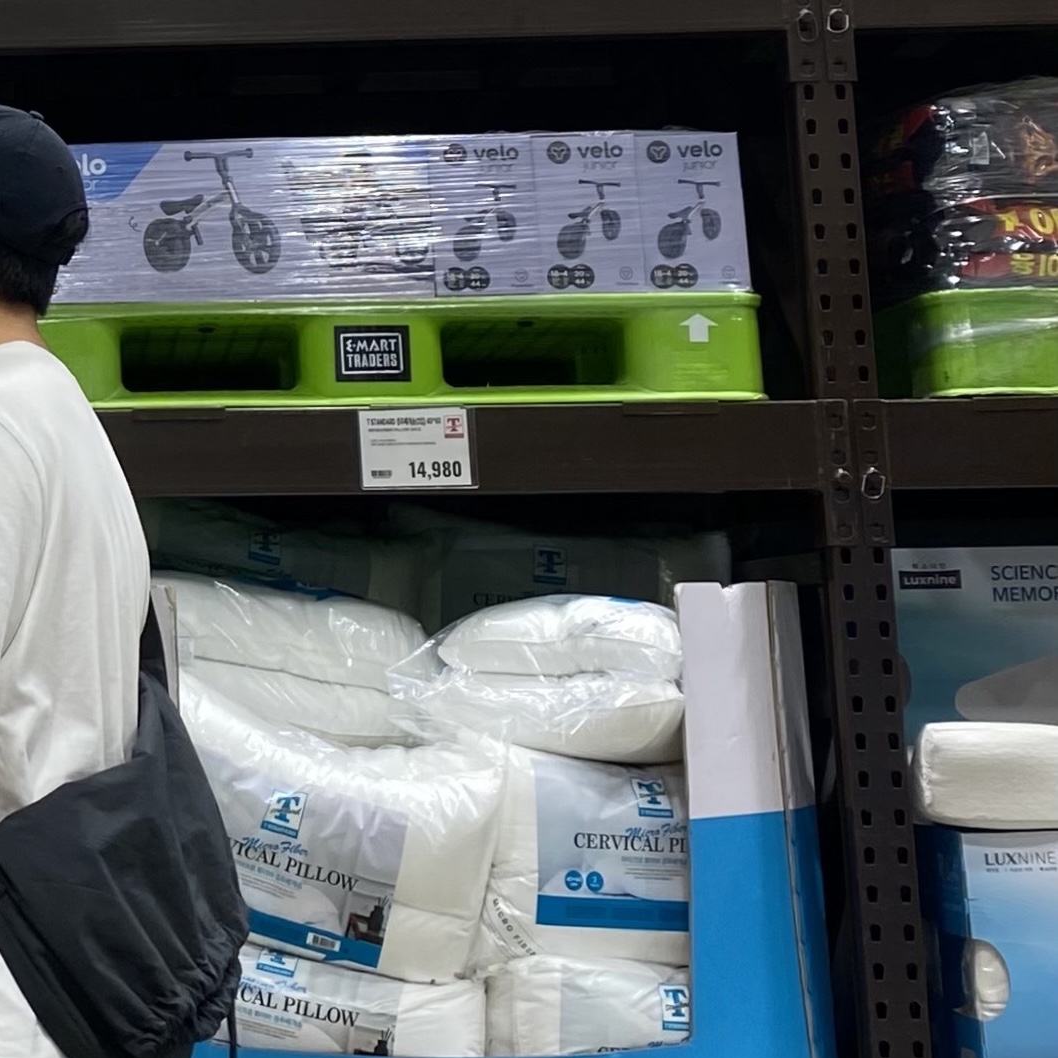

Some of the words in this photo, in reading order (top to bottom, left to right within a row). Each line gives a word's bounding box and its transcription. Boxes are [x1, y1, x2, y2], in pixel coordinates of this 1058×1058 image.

[577, 141, 624, 157] velo
[677, 140, 723, 157] velo
[75, 153, 107, 176] lo
[683, 159, 718, 172] junior
[346, 354, 398, 368] TRADERS
[408, 461, 462, 480] 14,980
[573, 832, 665, 853] CERVICAL
[984, 851, 1057, 866] LUXNINE
[284, 856, 359, 892] PILLOW
[283, 993, 360, 1029] PILLOW
